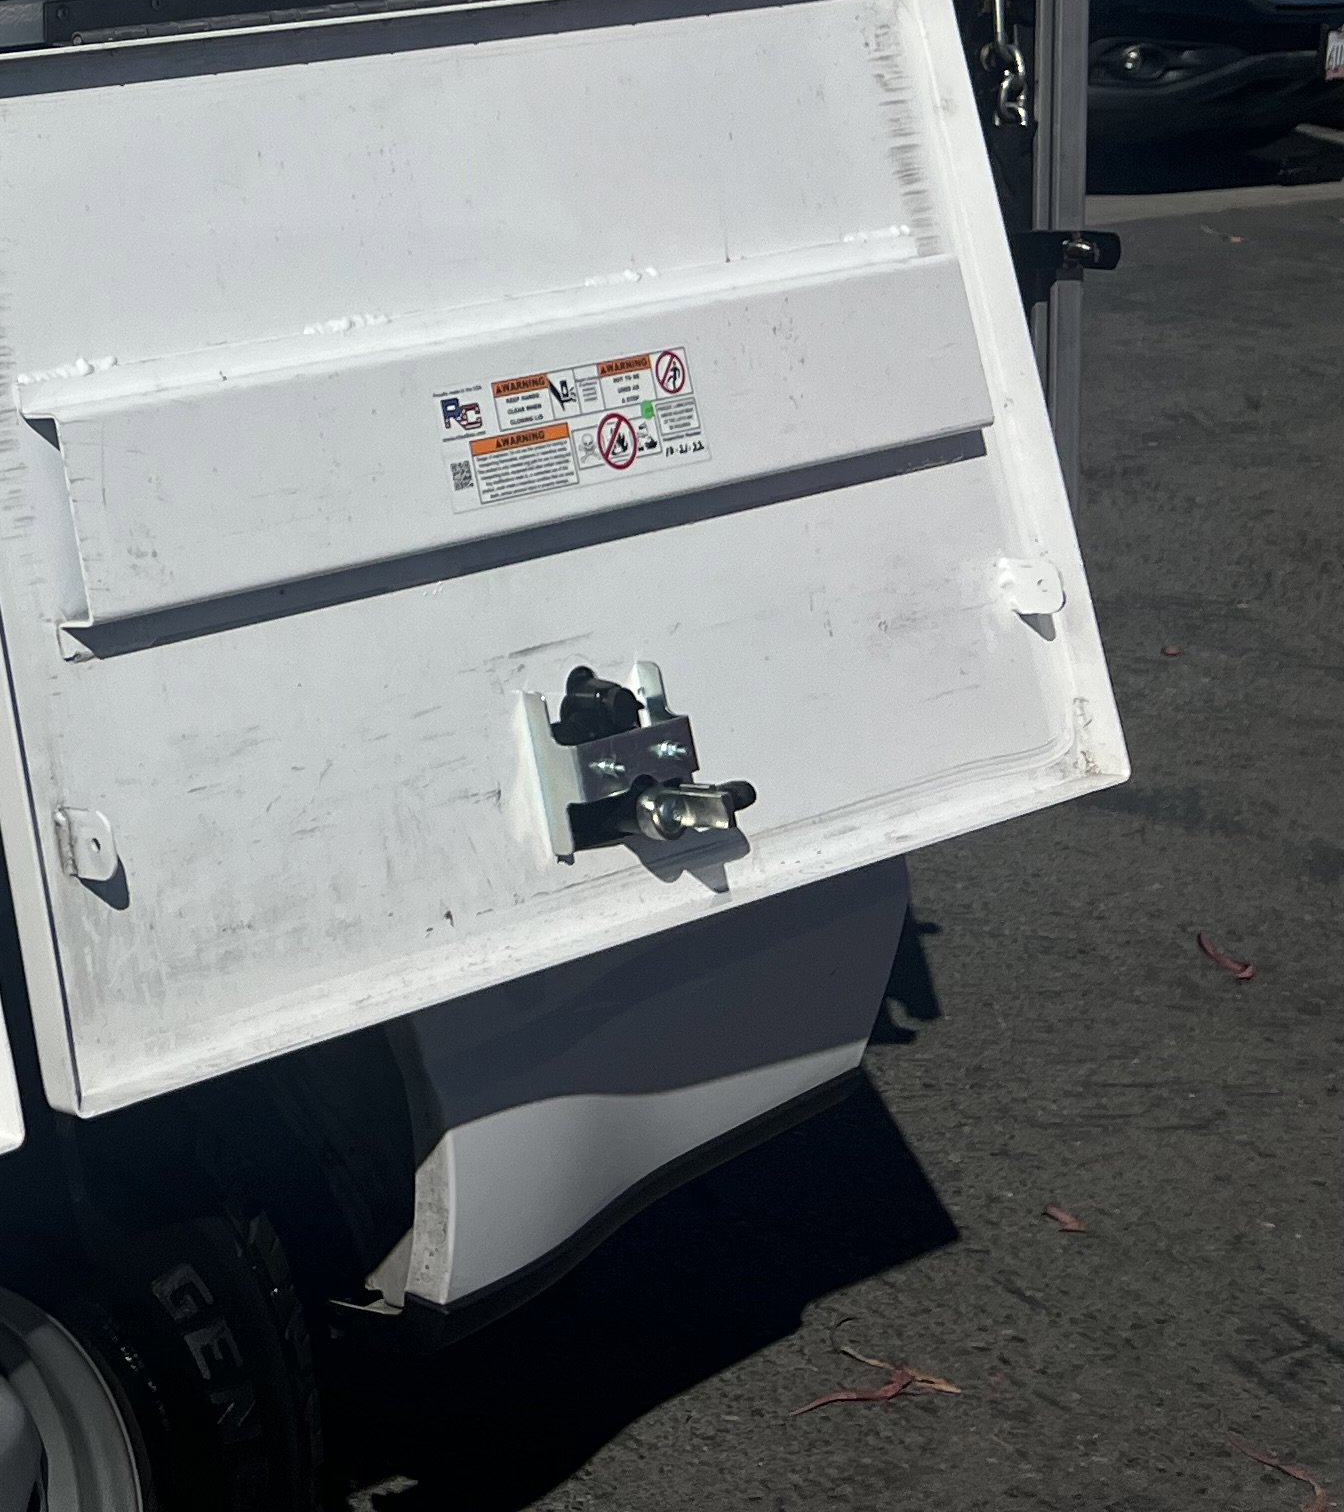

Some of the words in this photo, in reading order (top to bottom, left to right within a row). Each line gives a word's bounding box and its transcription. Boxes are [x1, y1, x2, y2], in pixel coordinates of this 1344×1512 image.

[606, 358, 647, 371] WARNING
[501, 376, 544, 391] WARNING
[501, 430, 544, 446] WARNING
